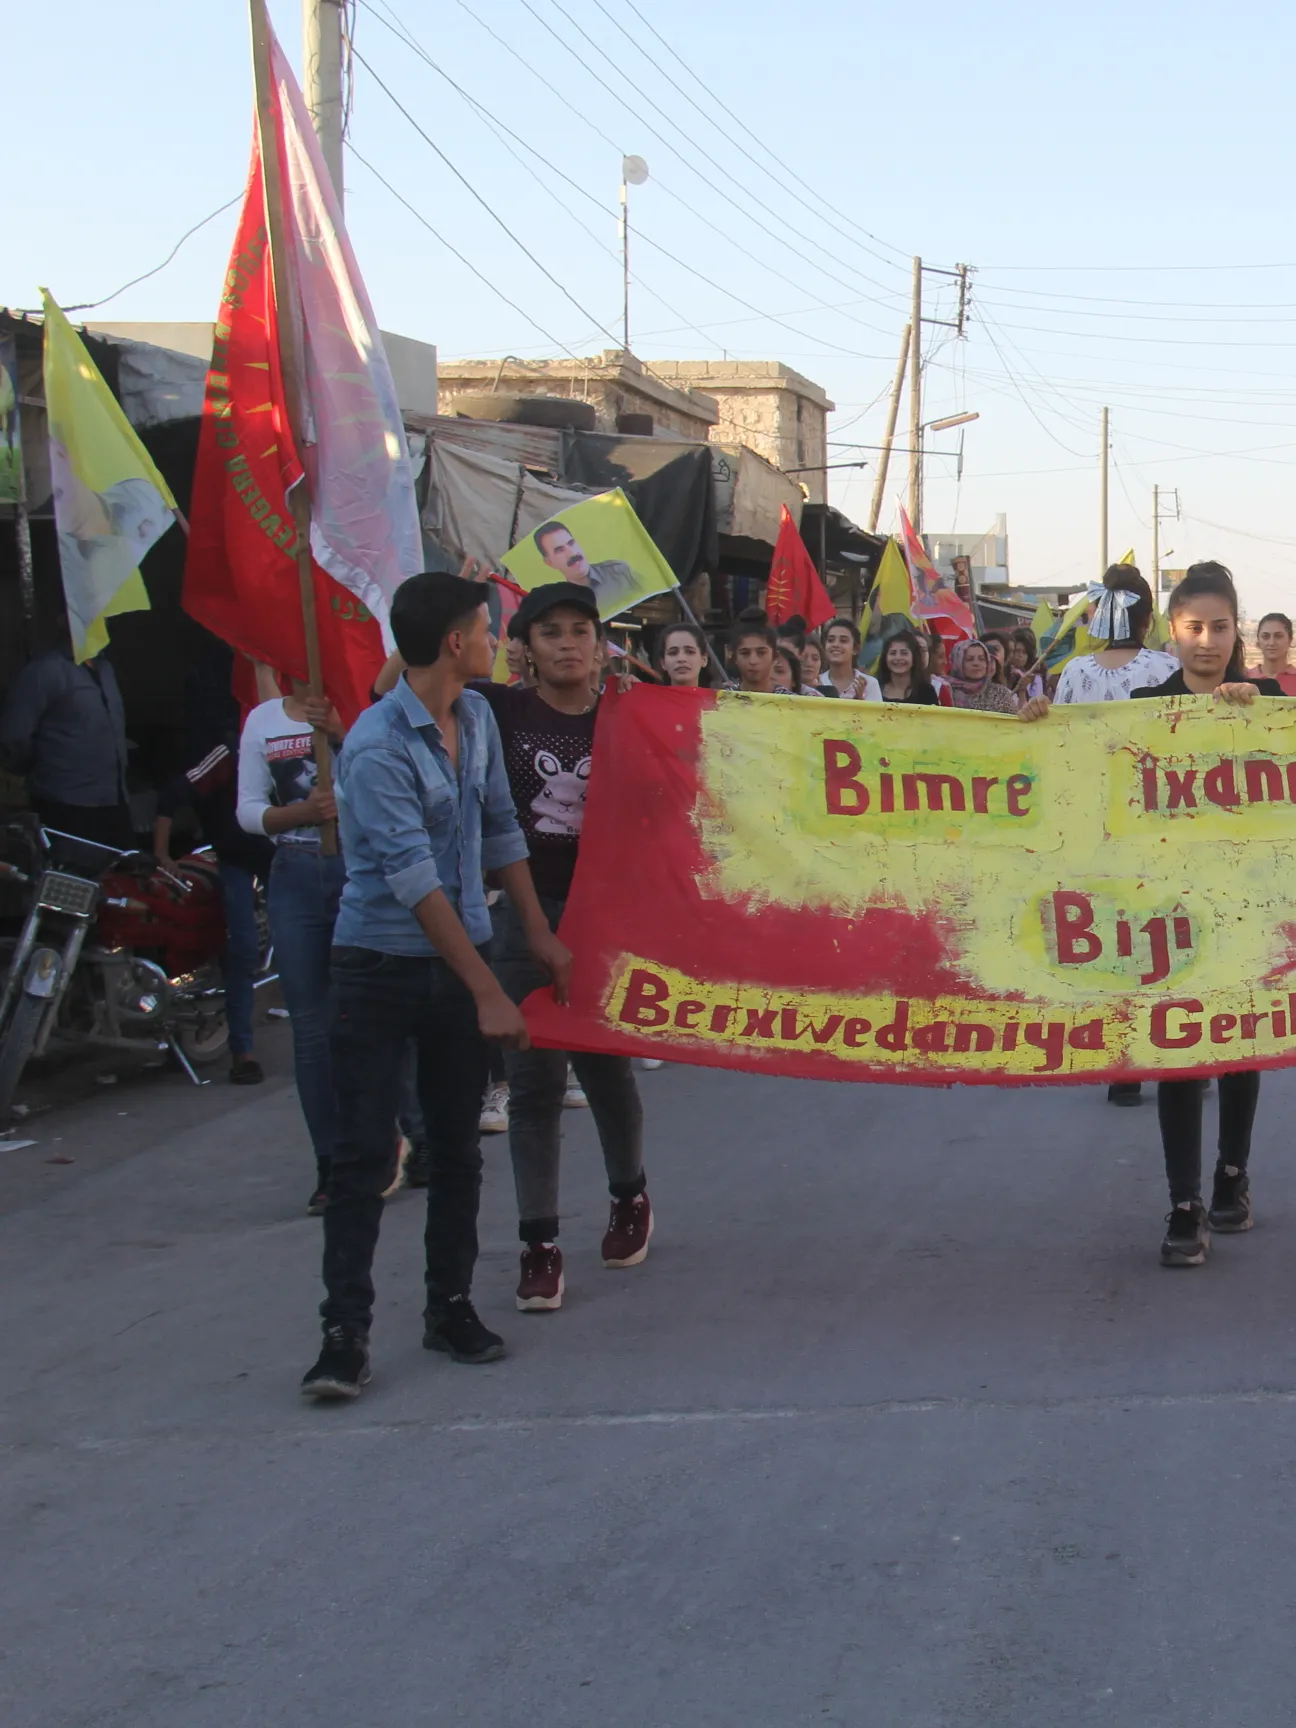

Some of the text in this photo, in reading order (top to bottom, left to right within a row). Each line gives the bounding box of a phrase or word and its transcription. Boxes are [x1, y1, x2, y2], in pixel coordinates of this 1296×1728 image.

[822, 738, 1034, 818] Bimre
[1052, 890, 1194, 986] Bijî
[618, 968, 1106, 1073] Berxwedaniya
